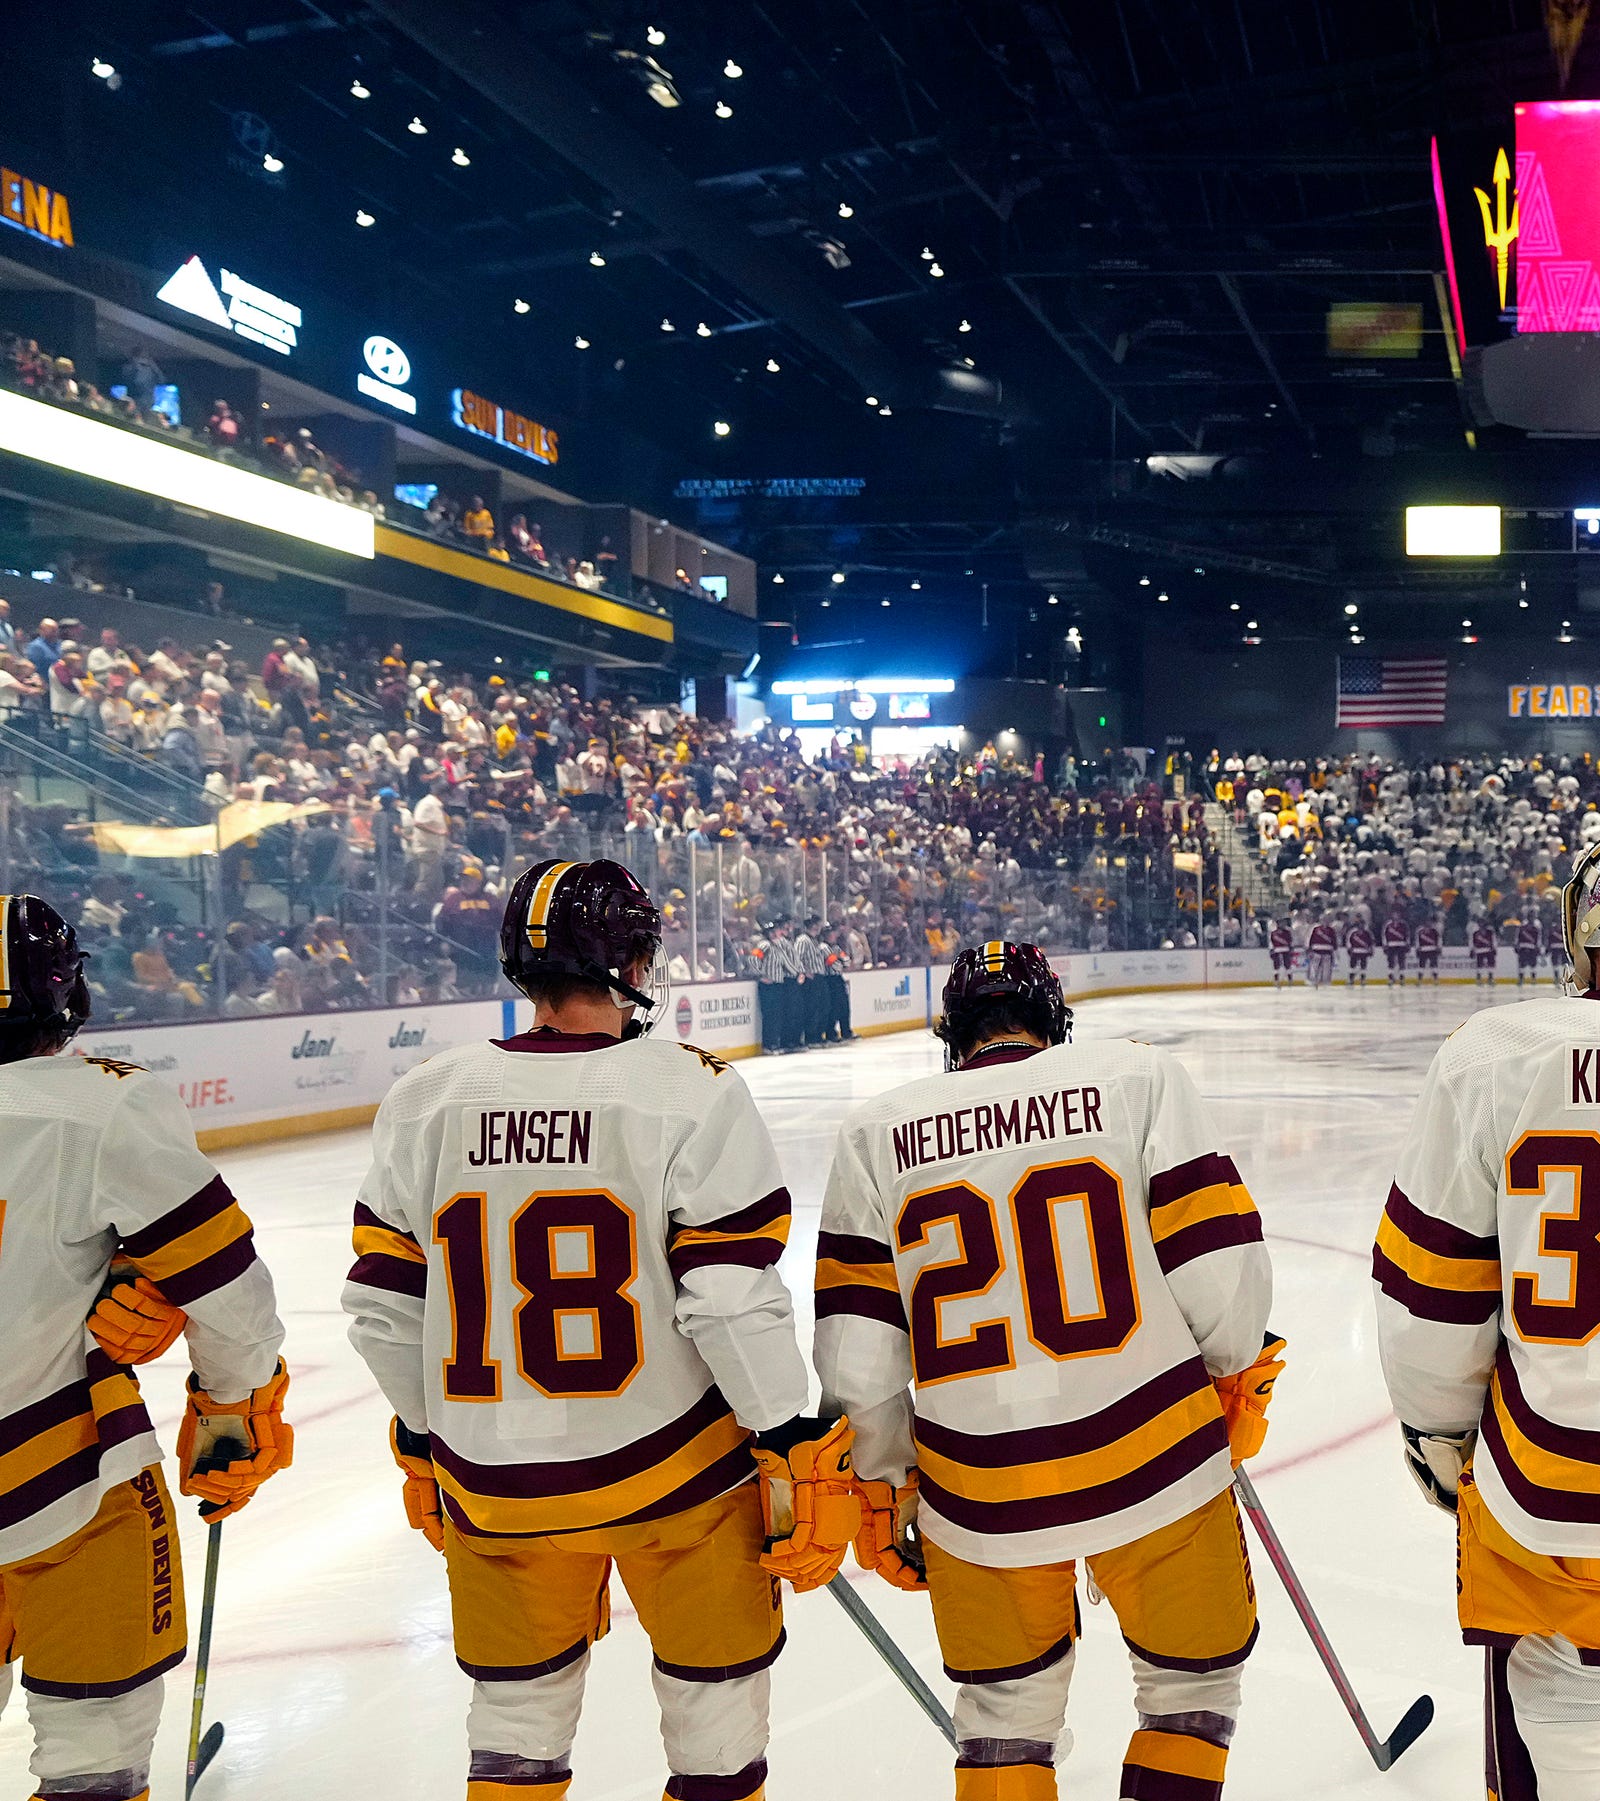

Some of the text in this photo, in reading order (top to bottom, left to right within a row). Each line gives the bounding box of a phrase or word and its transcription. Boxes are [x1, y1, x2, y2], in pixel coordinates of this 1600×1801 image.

[461, 389, 498, 438] SUN
[1508, 684, 1592, 717] FEAR
[722, 997, 745, 1011] BEERS
[874, 998, 911, 1013] Mortenson
[468, 1110, 592, 1166] JENSEN
[893, 1086, 1103, 1174] NIEDERMAYER
[432, 1187, 645, 1403] 18
[893, 1156, 1142, 1390] 20
[130, 1469, 172, 1636] SUN DEVILS
